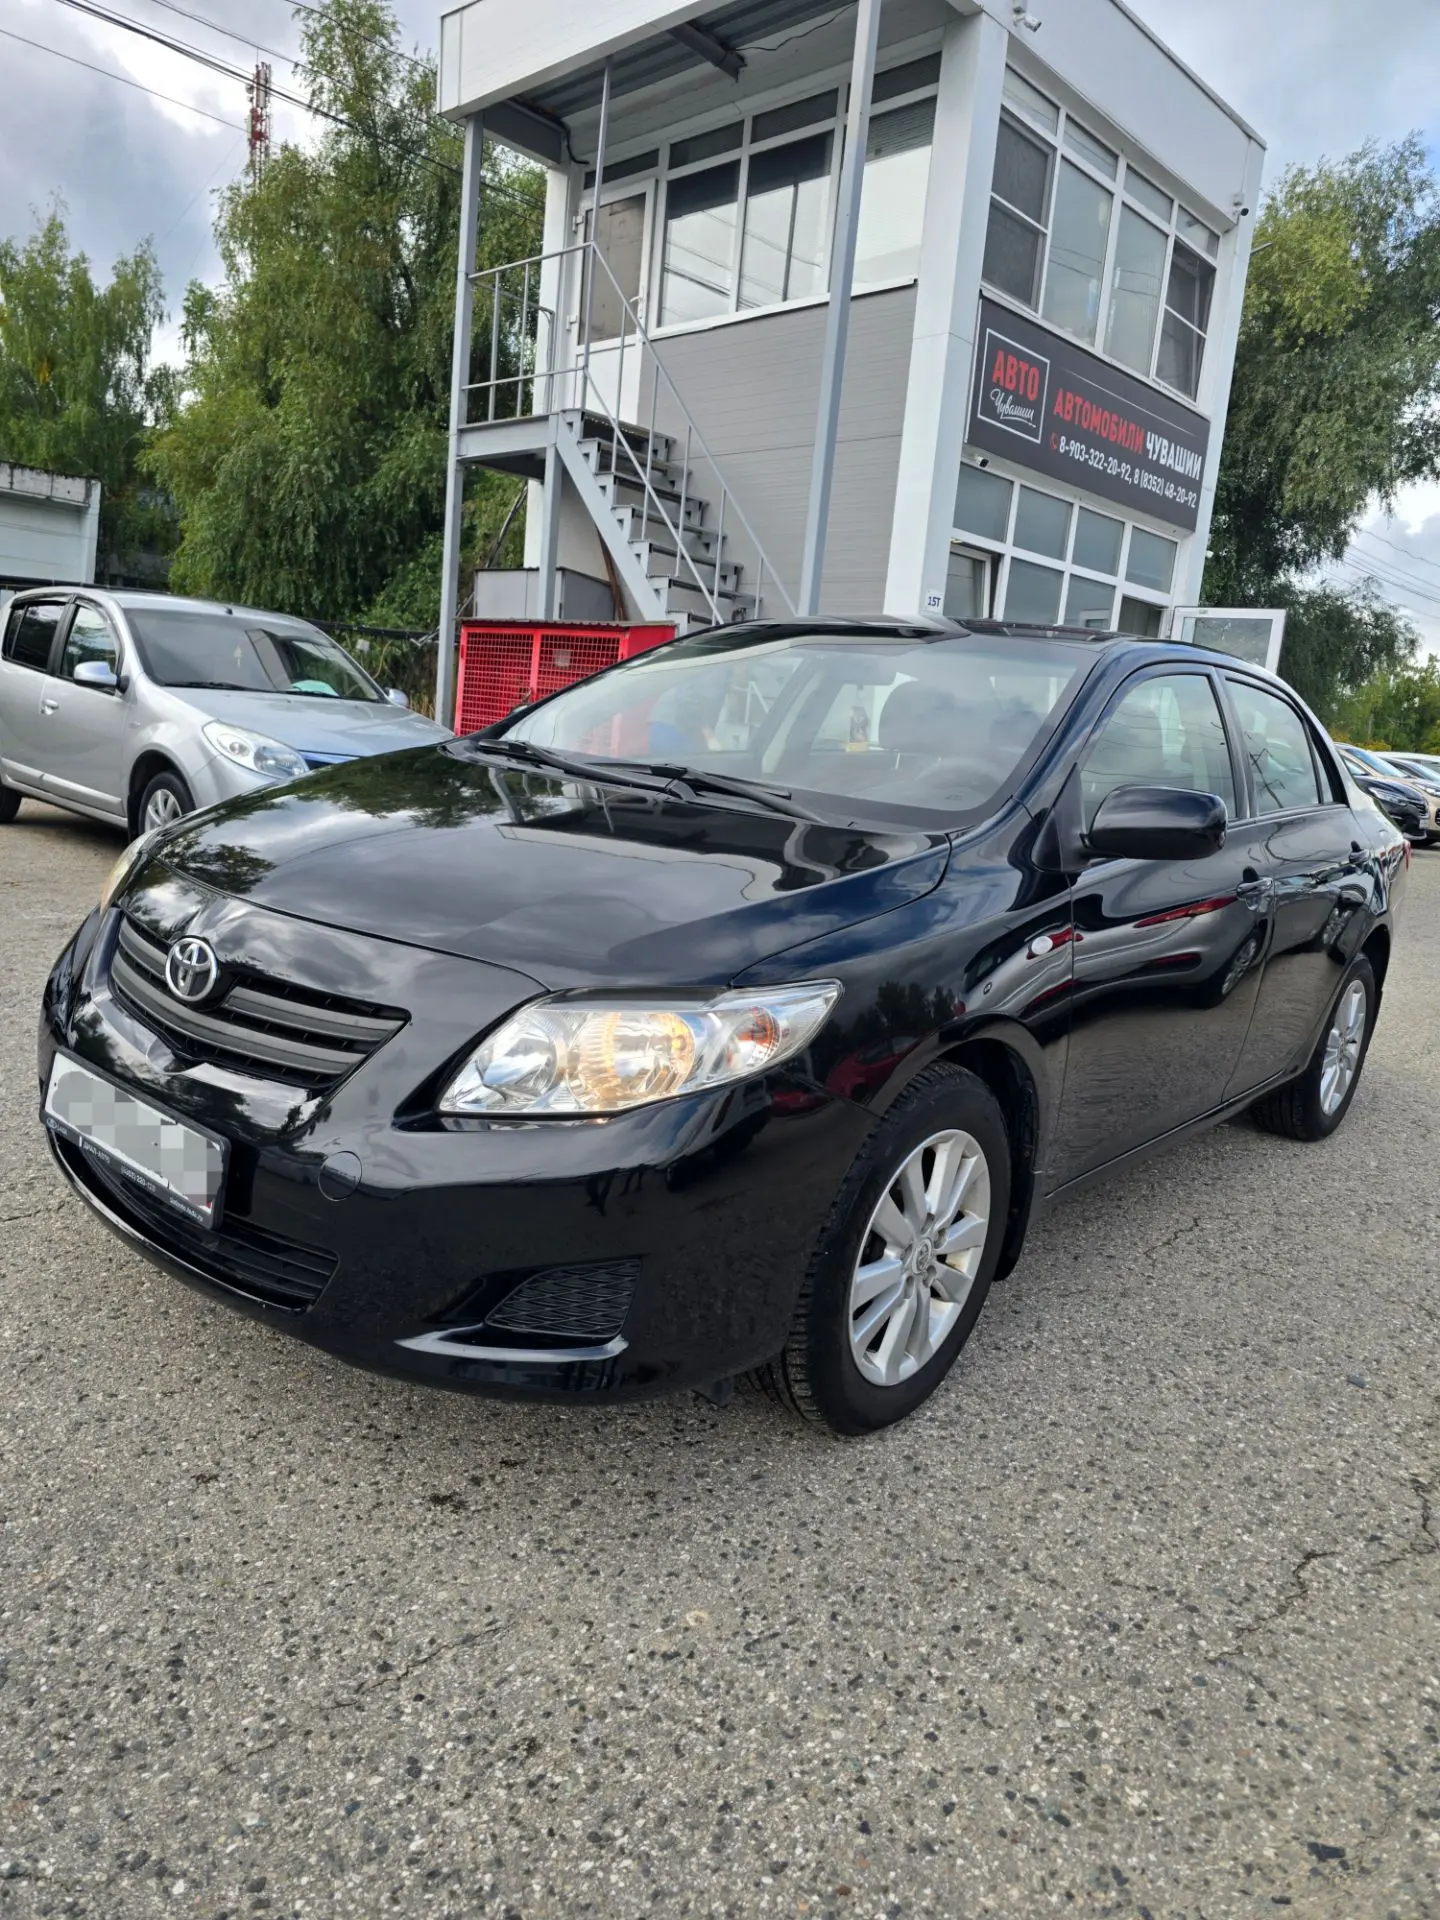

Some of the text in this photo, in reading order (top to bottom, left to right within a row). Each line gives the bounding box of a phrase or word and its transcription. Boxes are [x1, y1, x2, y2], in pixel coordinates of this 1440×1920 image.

[992, 350, 1040, 401] АВТО
[1053, 388, 1202, 481] АВТОМОБИЛИ ЧУВАШИИ
[1059, 435, 1197, 508] 8-903-322-20-92, 8 (8352) 48-20-92
